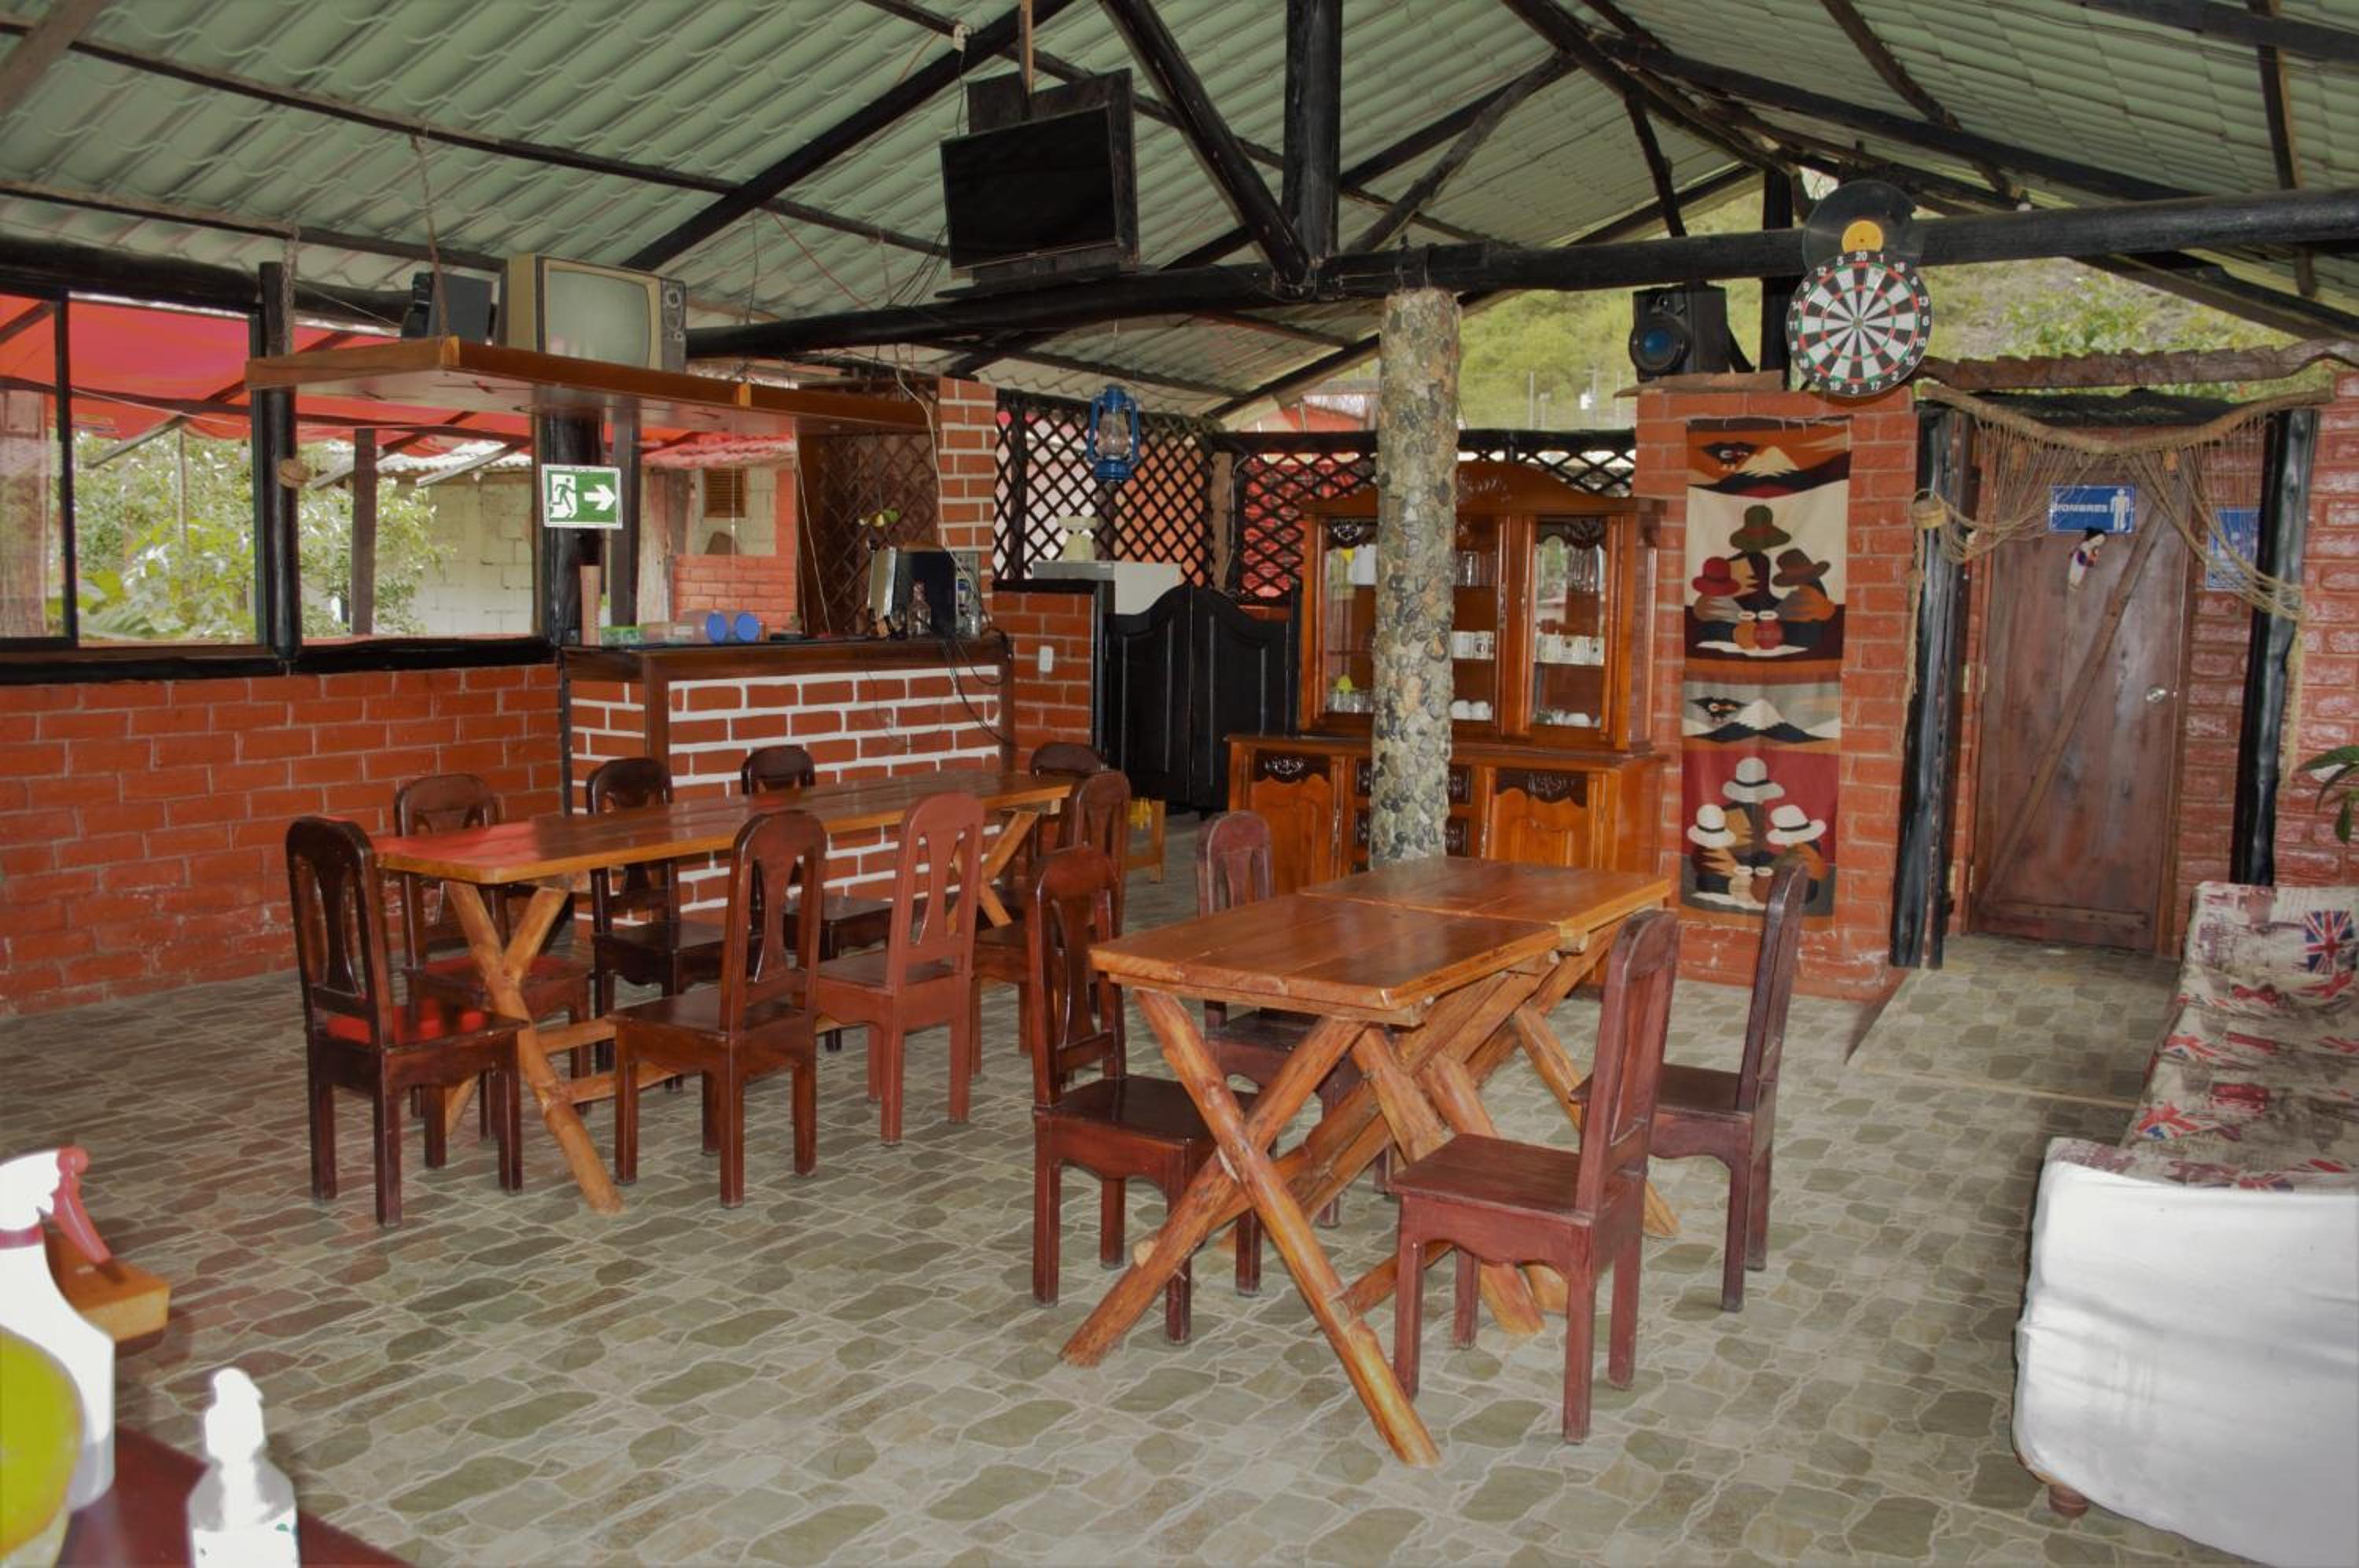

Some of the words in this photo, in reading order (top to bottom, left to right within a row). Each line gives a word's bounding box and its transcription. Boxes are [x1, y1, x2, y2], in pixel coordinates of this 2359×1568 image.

[1856, 251, 1868, 262] 20
[1879, 253, 1886, 263] 1
[1816, 267, 1827, 277] 12
[1910, 276, 1919, 286] 4
[1802, 282, 1811, 292] 9
[1791, 301, 1802, 311] 14
[1919, 296, 1929, 307] 13
[1789, 320, 1798, 331] 11
[1922, 315, 1930, 326] 6
[1916, 337, 1927, 348] 10
[1814, 373, 1822, 382] 7
[1891, 370, 1900, 381] 2
[1850, 384, 1859, 394] 3
[1870, 381, 1882, 391] 17
